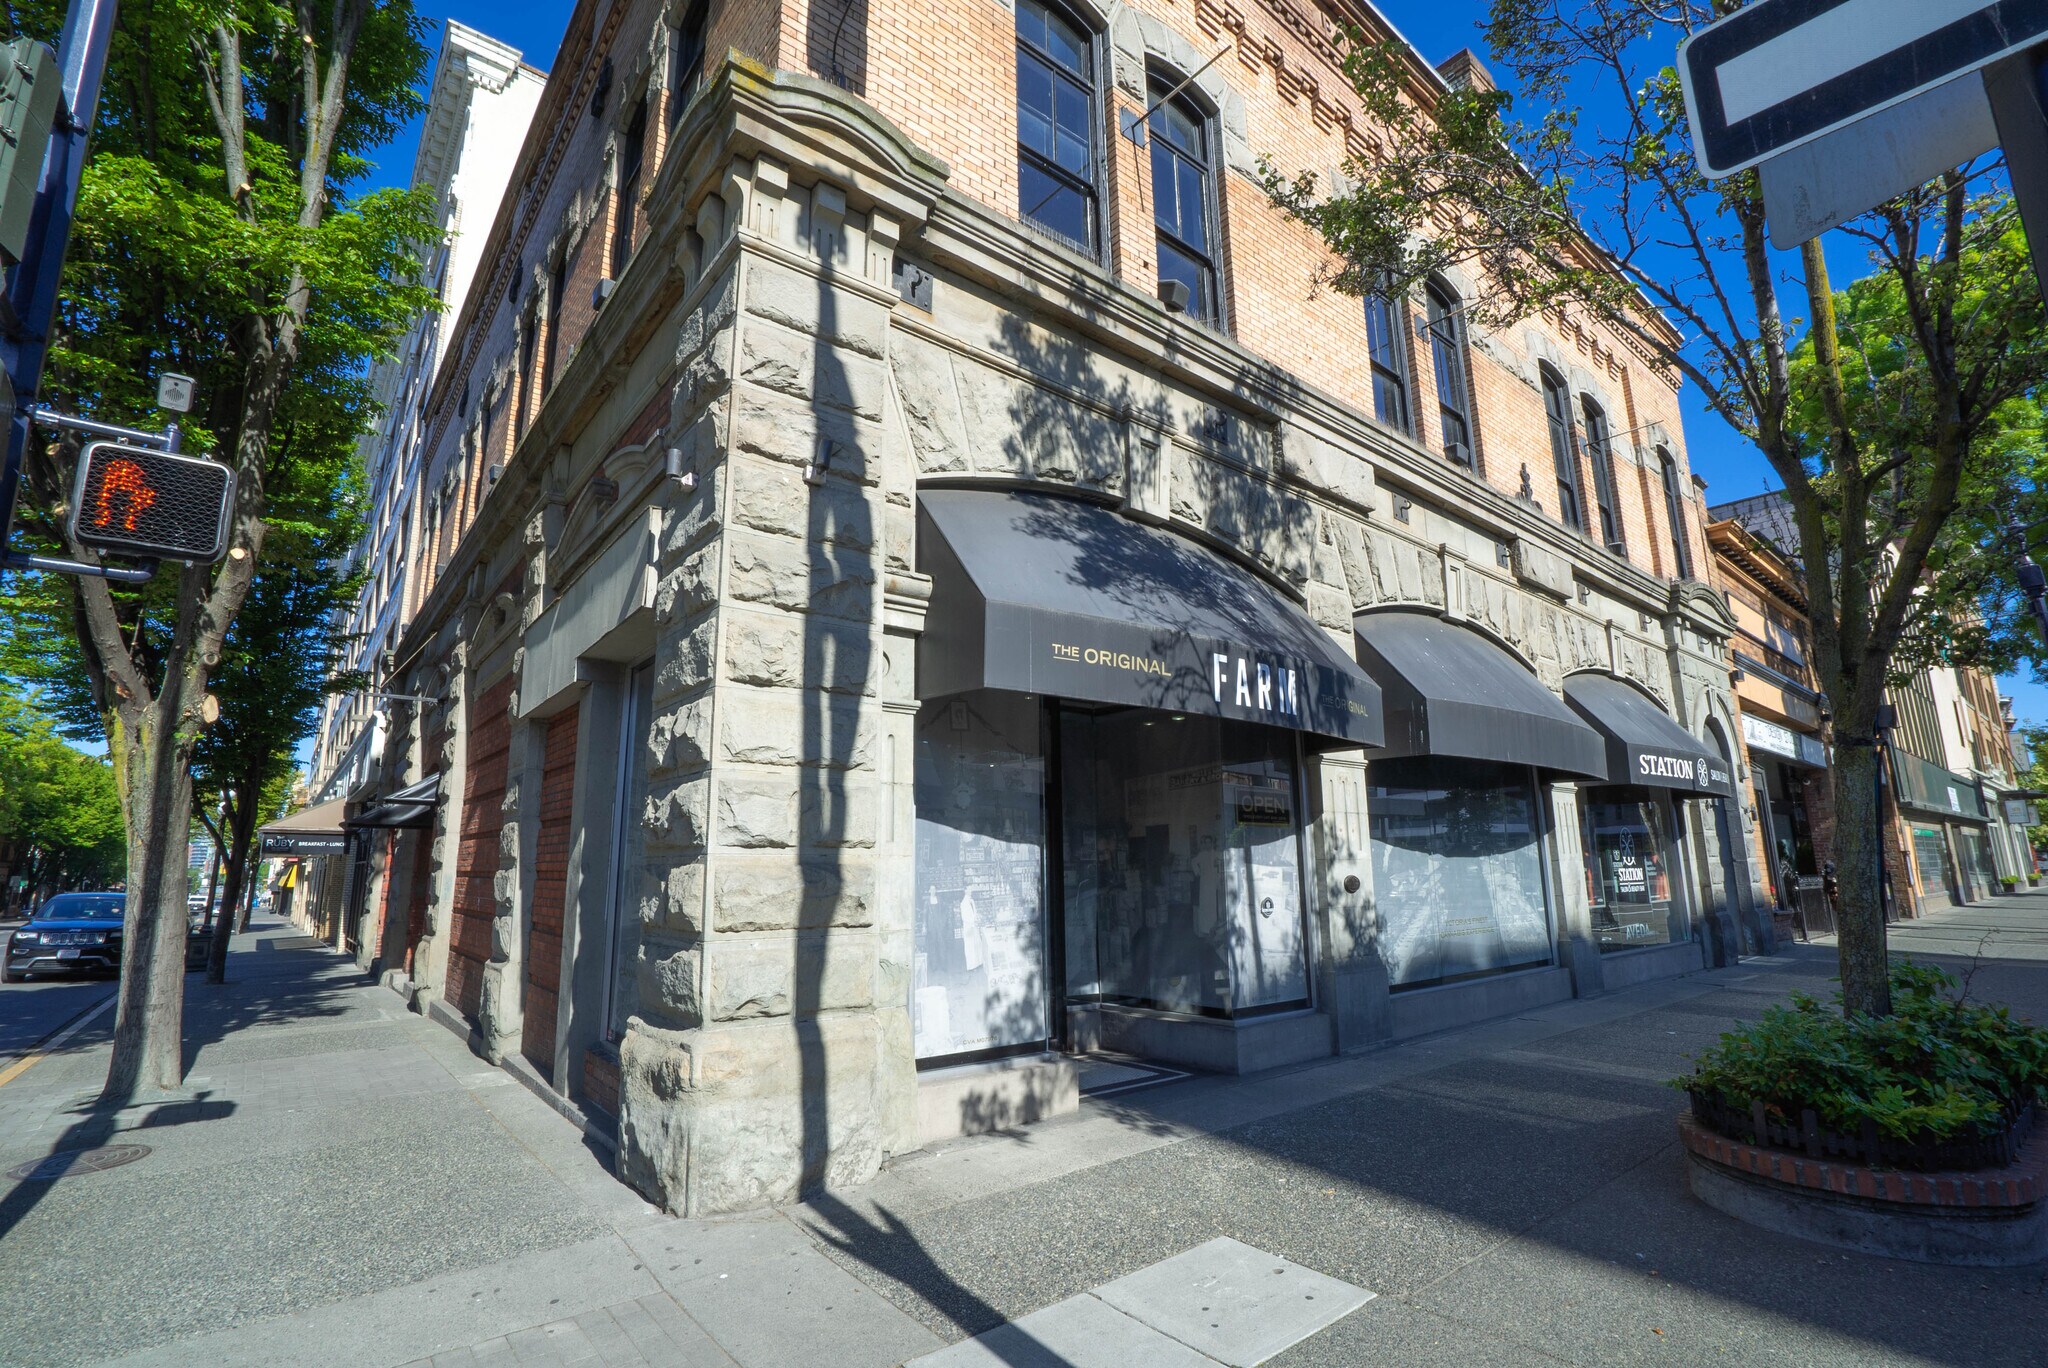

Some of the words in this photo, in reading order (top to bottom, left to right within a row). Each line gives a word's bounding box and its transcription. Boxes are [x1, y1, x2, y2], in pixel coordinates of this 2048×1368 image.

[1052, 643, 1080, 658] THE
[1084, 648, 1172, 677] ORIGINAL
[1213, 652, 1297, 716] FARM
[1334, 696, 1369, 718] ORIGINAL
[1639, 754, 1694, 780] STATION
[1241, 795, 1285, 814] OPEN
[266, 839, 295, 847] RUBY
[1618, 867, 1644, 881] STATION
[1626, 922, 1650, 940] AVEDA
